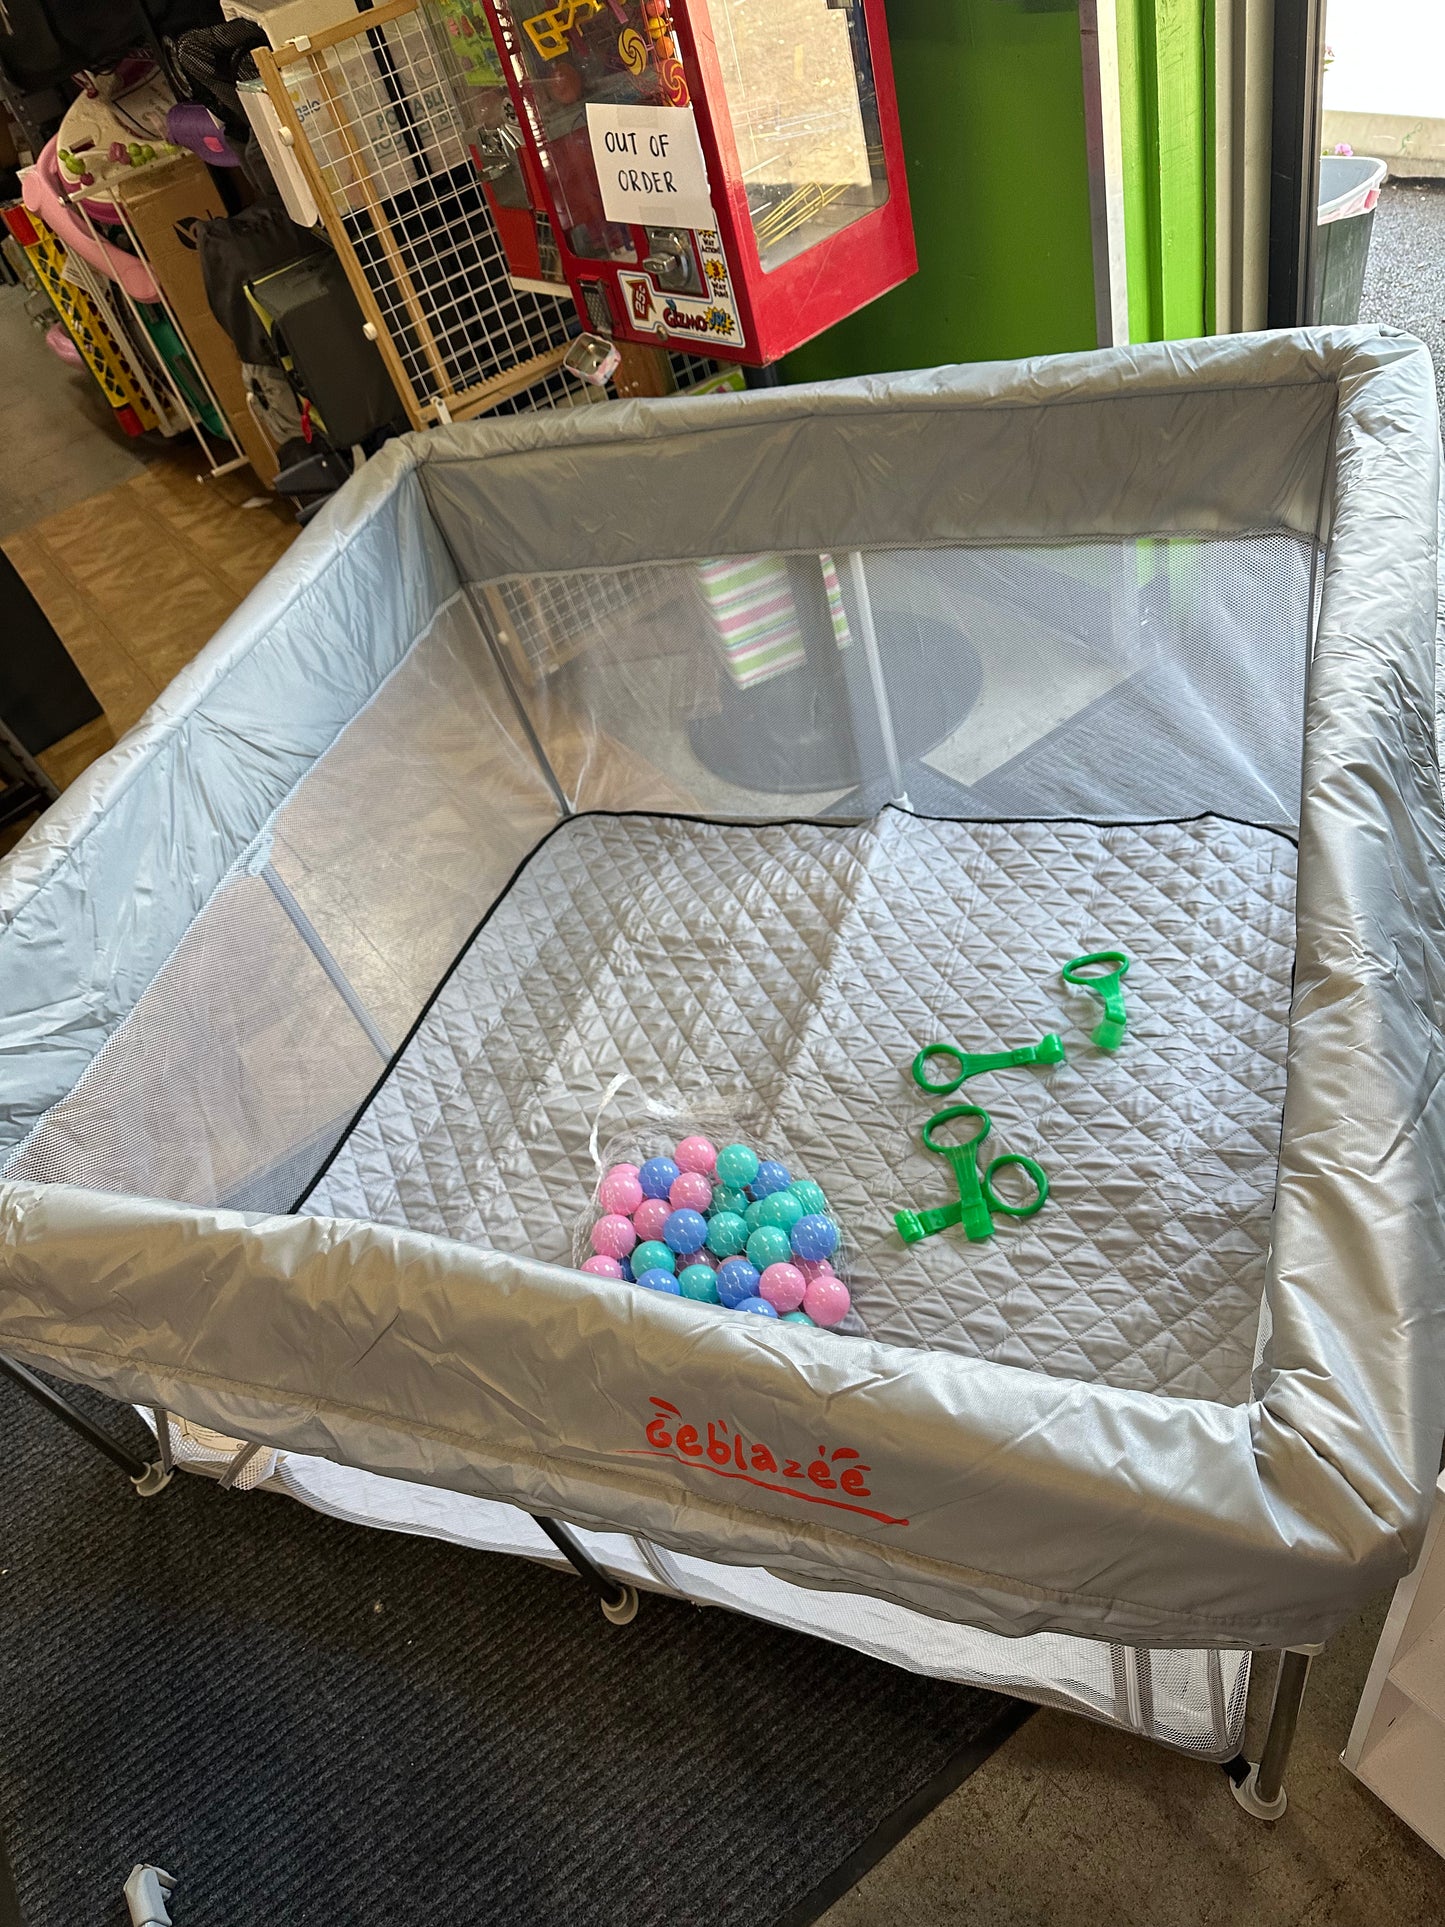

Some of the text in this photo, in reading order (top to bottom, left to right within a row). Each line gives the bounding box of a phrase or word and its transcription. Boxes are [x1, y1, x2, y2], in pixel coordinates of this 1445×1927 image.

[605, 131, 669, 157] OUT OF
[618, 169, 677, 193] ORDER
